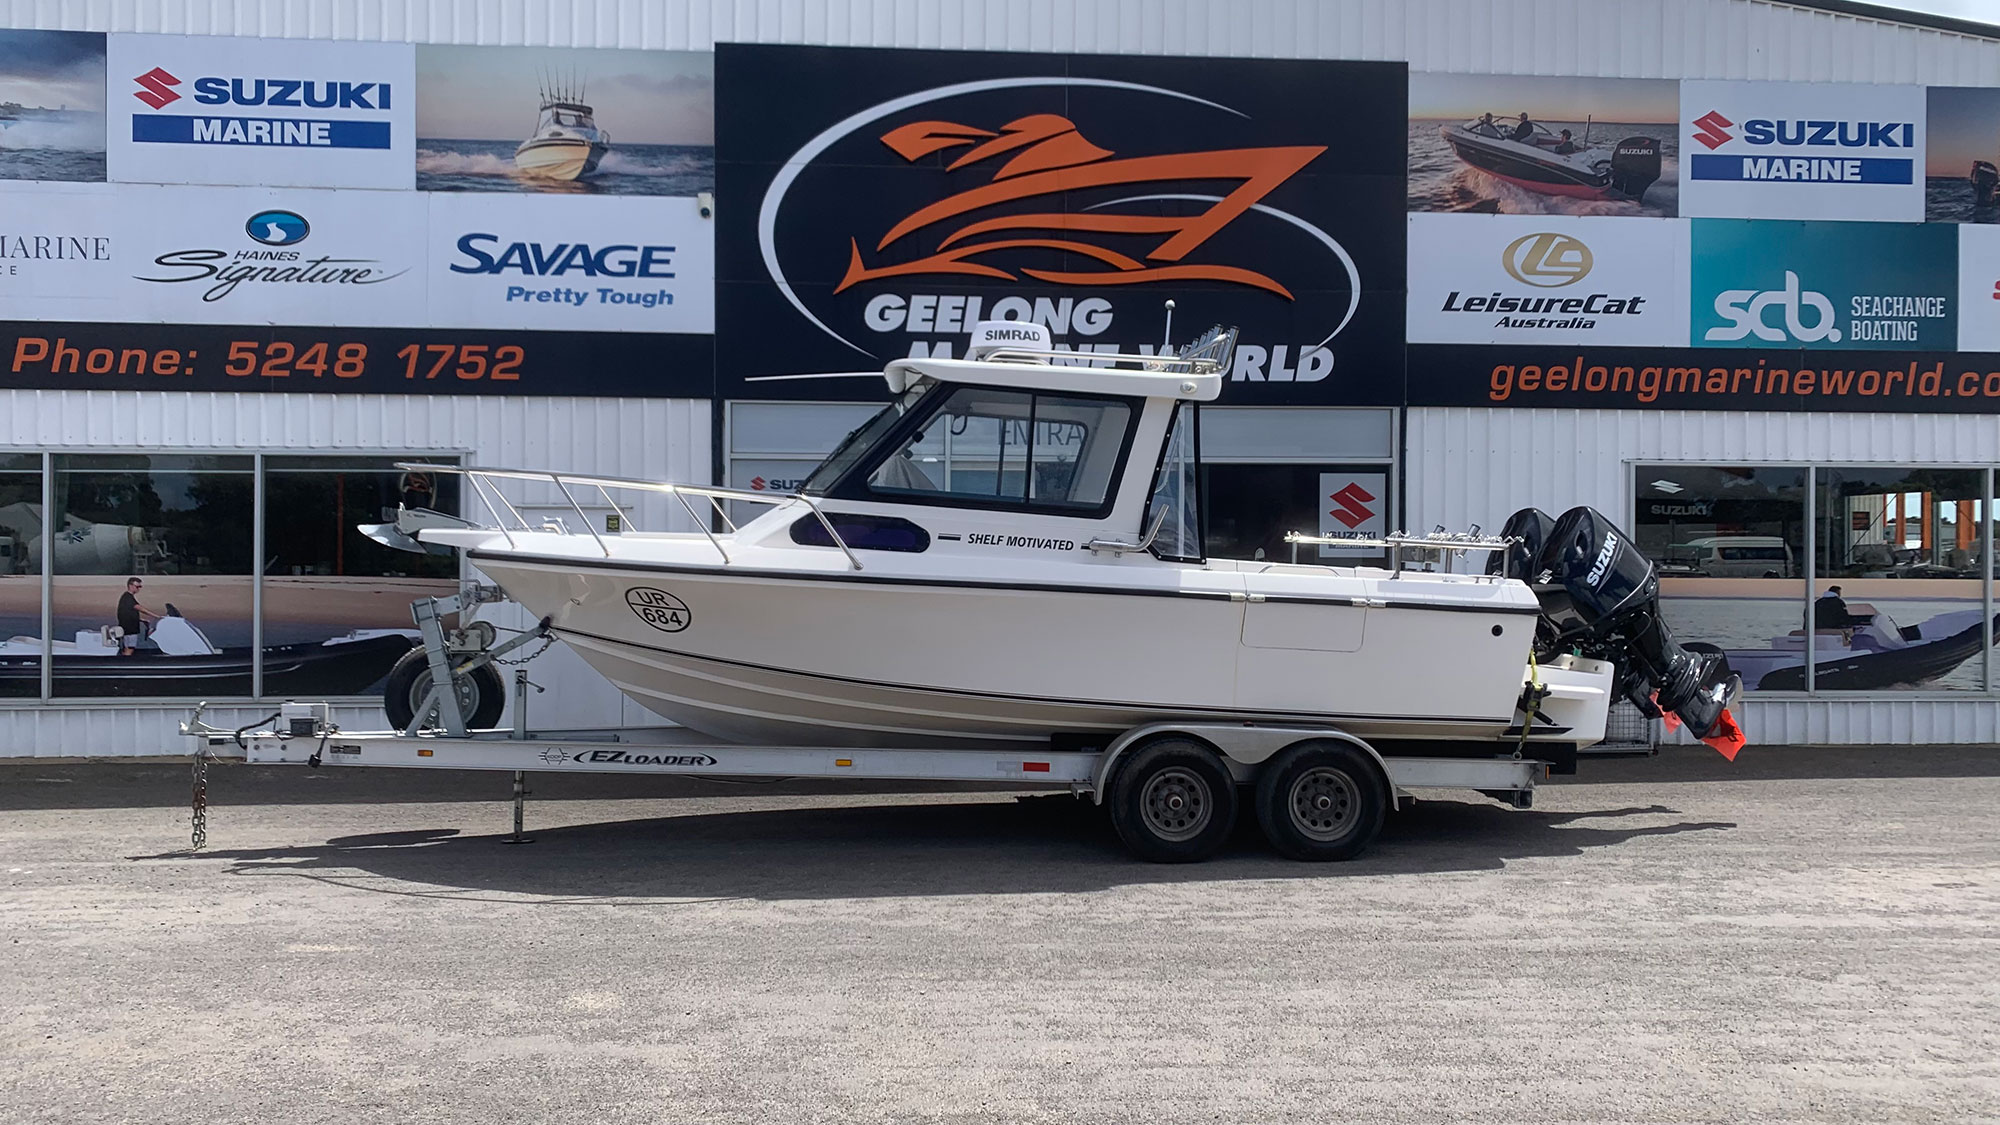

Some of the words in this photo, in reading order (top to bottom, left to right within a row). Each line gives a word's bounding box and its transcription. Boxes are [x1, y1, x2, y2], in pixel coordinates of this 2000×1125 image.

[194, 77, 391, 110] SUZUKI
[193, 119, 331, 145] MARINE
[1744, 120, 1914, 148] SUZUKI
[1743, 158, 1862, 181] MARINE
[234, 250, 300, 261] HAINES
[450, 233, 676, 278] SAVAGE
[132, 249, 413, 302] Signature
[506, 286, 589, 306] Pretty
[597, 288, 674, 307] Tough
[1441, 292, 1646, 315] LeisureCat
[1851, 296, 1946, 318] SEACHANGE
[864, 293, 1113, 336] GEELONG
[1495, 317, 1597, 329] Australia
[984, 329, 1041, 342] SIMRAD
[1851, 320, 1918, 341] BOATING
[11, 337, 197, 376] Phone:
[225, 341, 368, 378] 5248
[397, 344, 525, 380] 1752
[1139, 344, 1335, 382] WRLD
[1489, 356, 2000, 402] geelongmarineworld.co
[1651, 504, 1707, 515] SUZUKI
[968, 533, 1004, 546] SHELF
[1006, 536, 1074, 551] MOTIVATED
[1586, 531, 1618, 587] SUZUKI
[635, 591, 670, 606] UR
[642, 607, 683, 626] 684
